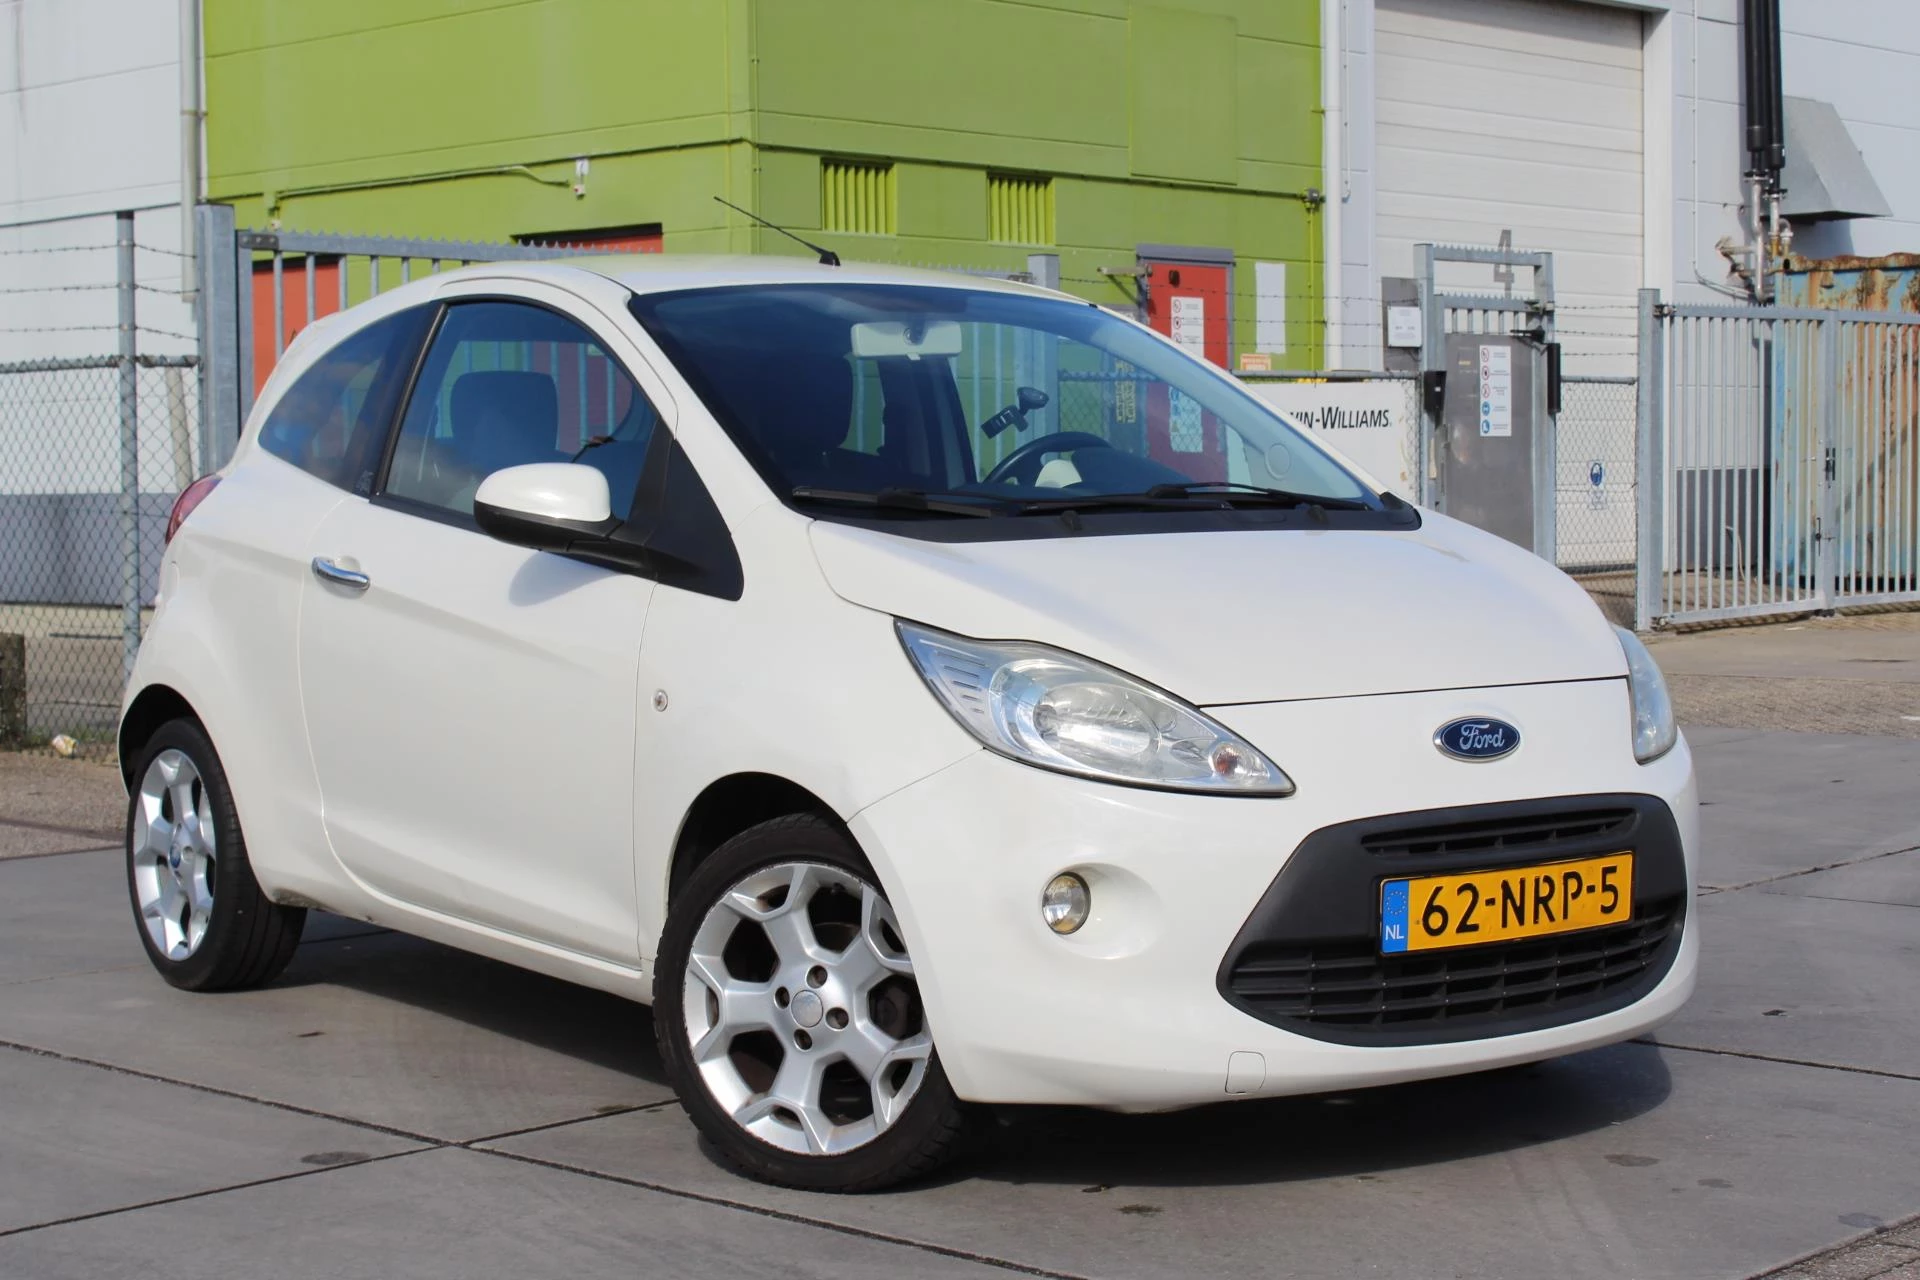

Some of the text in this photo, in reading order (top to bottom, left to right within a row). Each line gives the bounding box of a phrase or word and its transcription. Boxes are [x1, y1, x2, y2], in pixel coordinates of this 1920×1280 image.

[1493, 229, 1515, 299] 4
[1460, 723, 1505, 750] Ford
[1421, 865, 1619, 937] 62-NRP-5
[1385, 925, 1405, 941] NL
